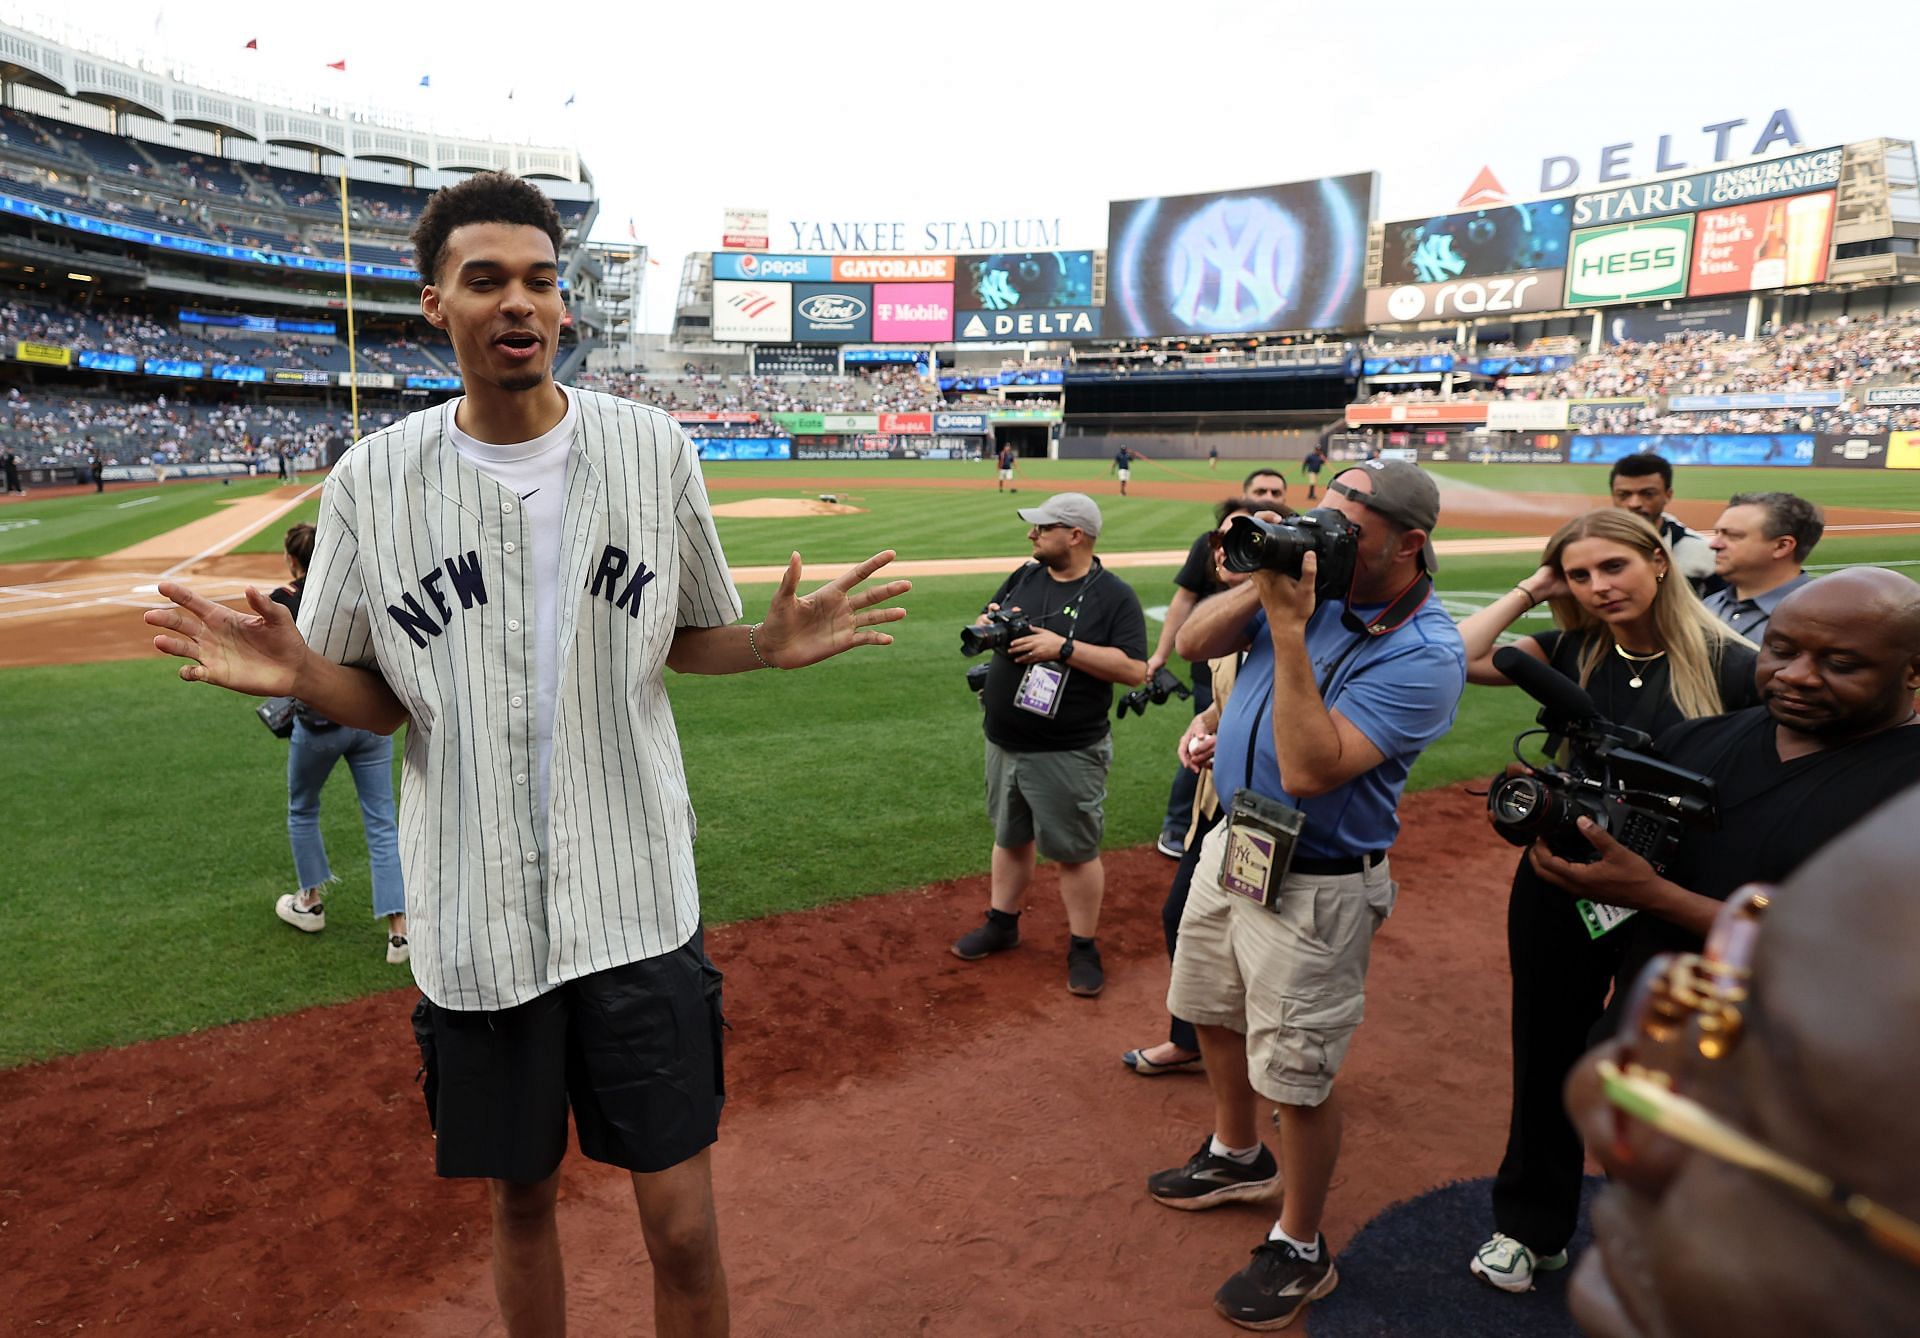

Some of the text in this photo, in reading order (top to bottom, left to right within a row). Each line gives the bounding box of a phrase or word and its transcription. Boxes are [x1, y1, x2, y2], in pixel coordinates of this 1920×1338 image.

[1540, 109, 1802, 193] DELTA
[1715, 150, 1842, 188] INSURANCE
[1712, 166, 1841, 202] COMPANIES
[1573, 180, 1698, 225] STARR
[1703, 211, 1748, 231] This
[790, 218, 1061, 251] YANKEE STADIUM
[1702, 225, 1754, 246] Bud's
[1581, 247, 1676, 277] HESS
[1701, 246, 1732, 260] For
[761, 259, 809, 277] pepsi
[840, 260, 947, 278] GATORADE
[810, 298, 855, 319] Ford
[1434, 276, 1538, 315] razr
[895, 304, 949, 321] Mobile
[995, 312, 1093, 335] DELTA
[387, 545, 656, 650] NEW RK
